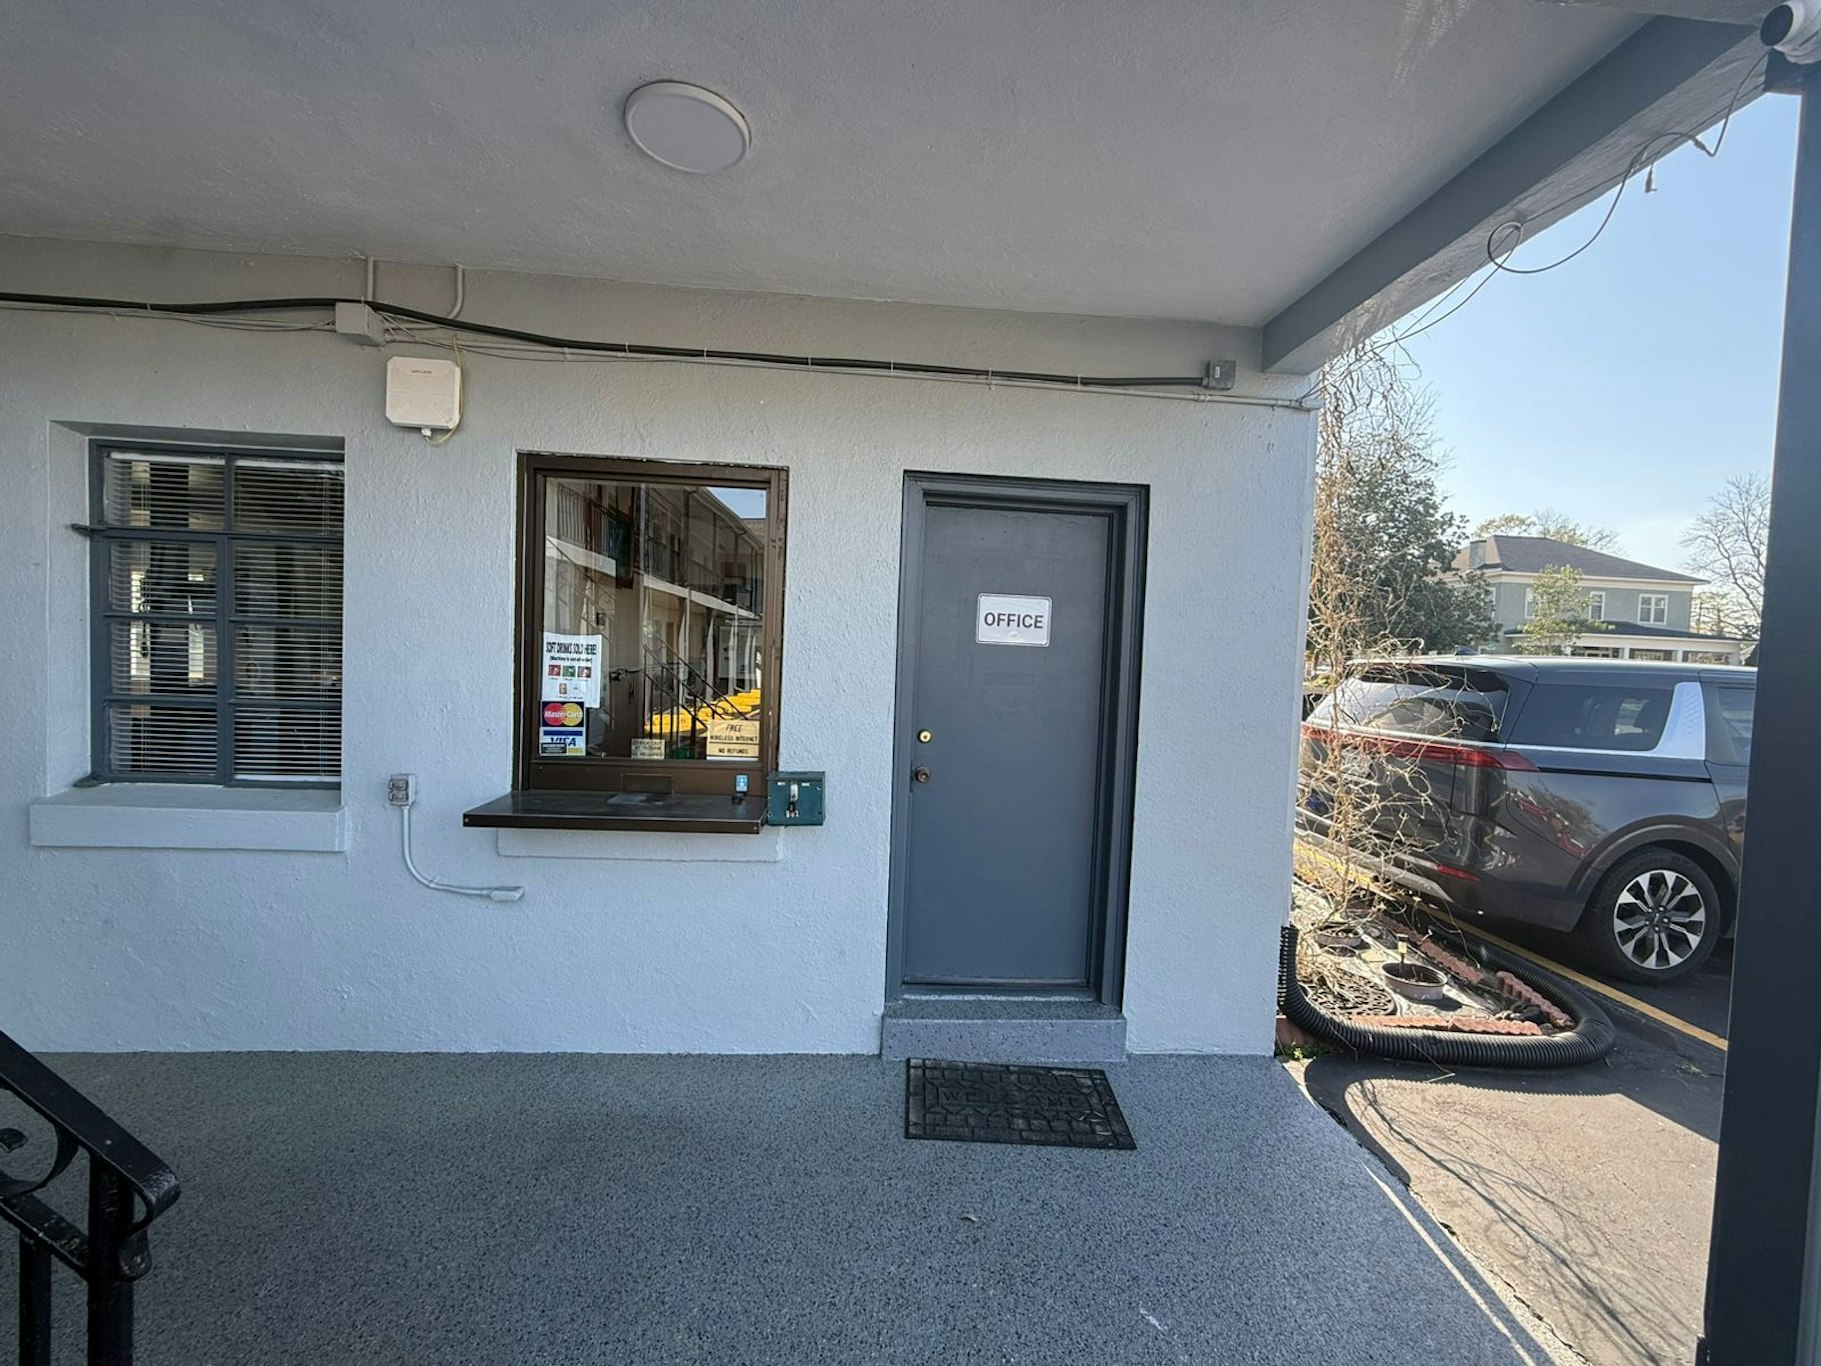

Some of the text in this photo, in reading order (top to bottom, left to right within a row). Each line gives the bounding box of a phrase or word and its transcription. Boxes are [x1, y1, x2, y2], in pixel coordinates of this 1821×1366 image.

[984, 612, 1044, 628] OFFICE
[546, 641, 556, 653] SOFT
[557, 642, 572, 654] DRINKS
[572, 643, 583, 655] SOLD
[544, 710, 583, 718] MasterCard
[725, 724, 743, 733] FREE
